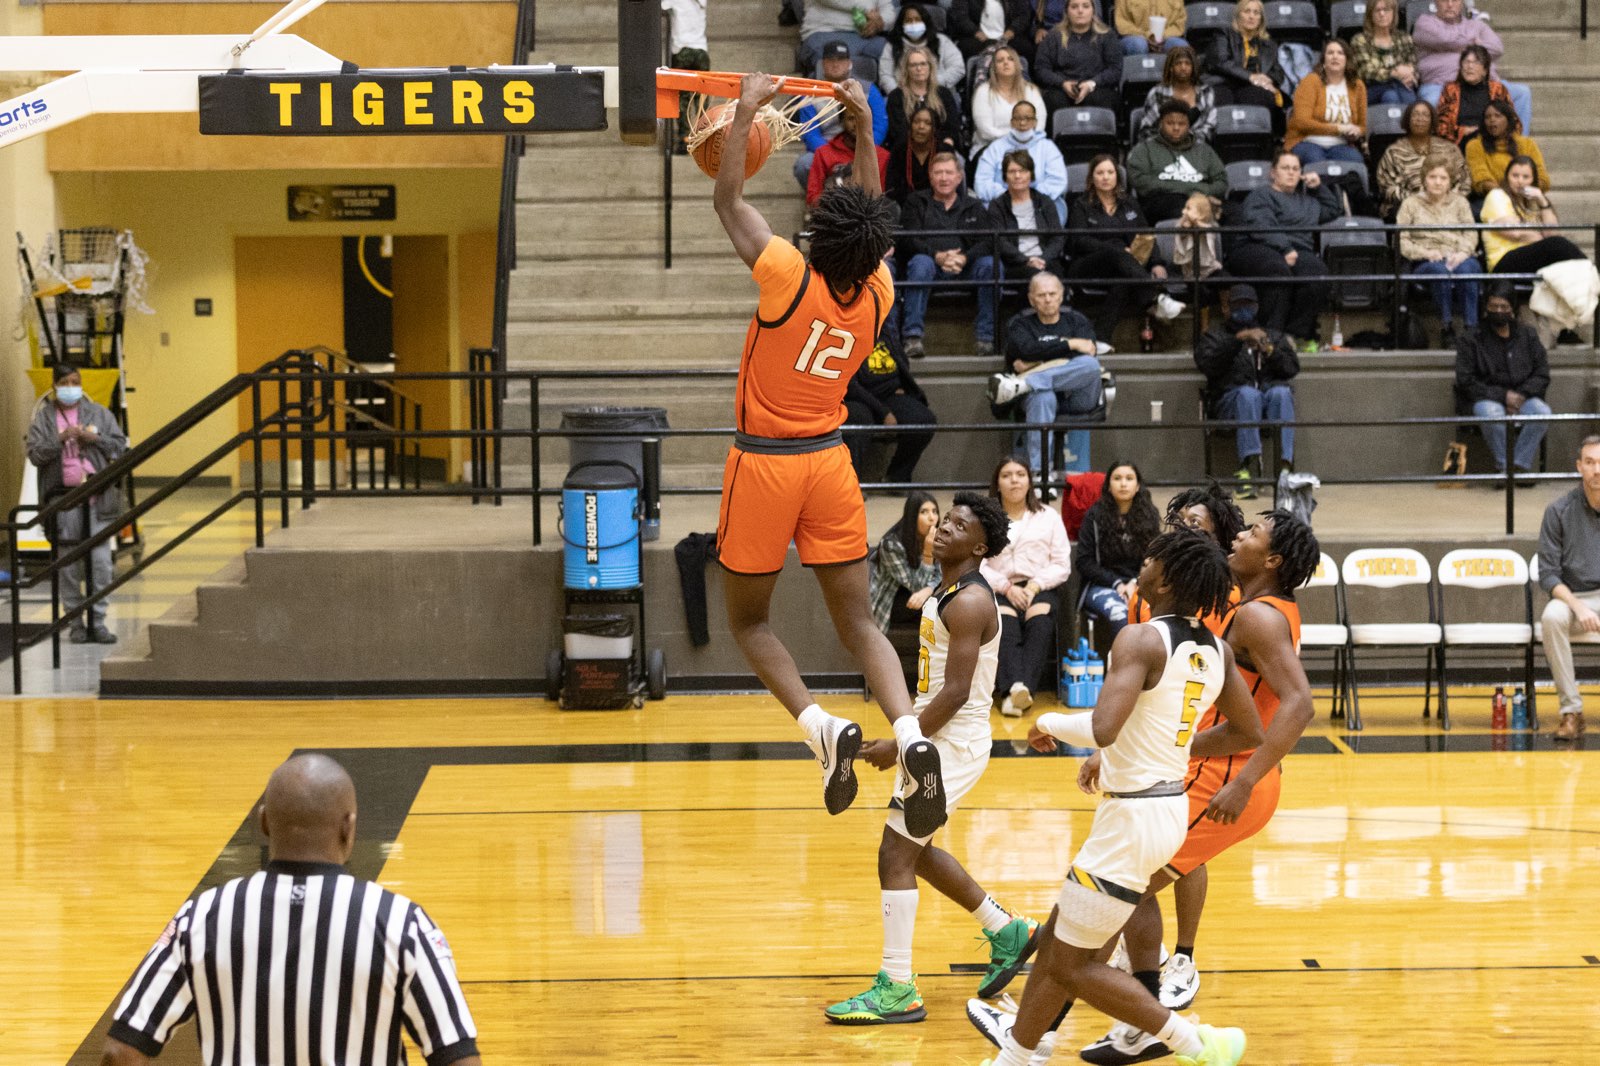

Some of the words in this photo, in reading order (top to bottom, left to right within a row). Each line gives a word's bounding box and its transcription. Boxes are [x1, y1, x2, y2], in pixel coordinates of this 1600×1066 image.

[270, 80, 535, 126] TIGERS
[793, 317, 856, 380] 12
[1355, 557, 1418, 578] TIGERS
[1452, 557, 1515, 578] TIGERS
[1174, 680, 1205, 748] 5
